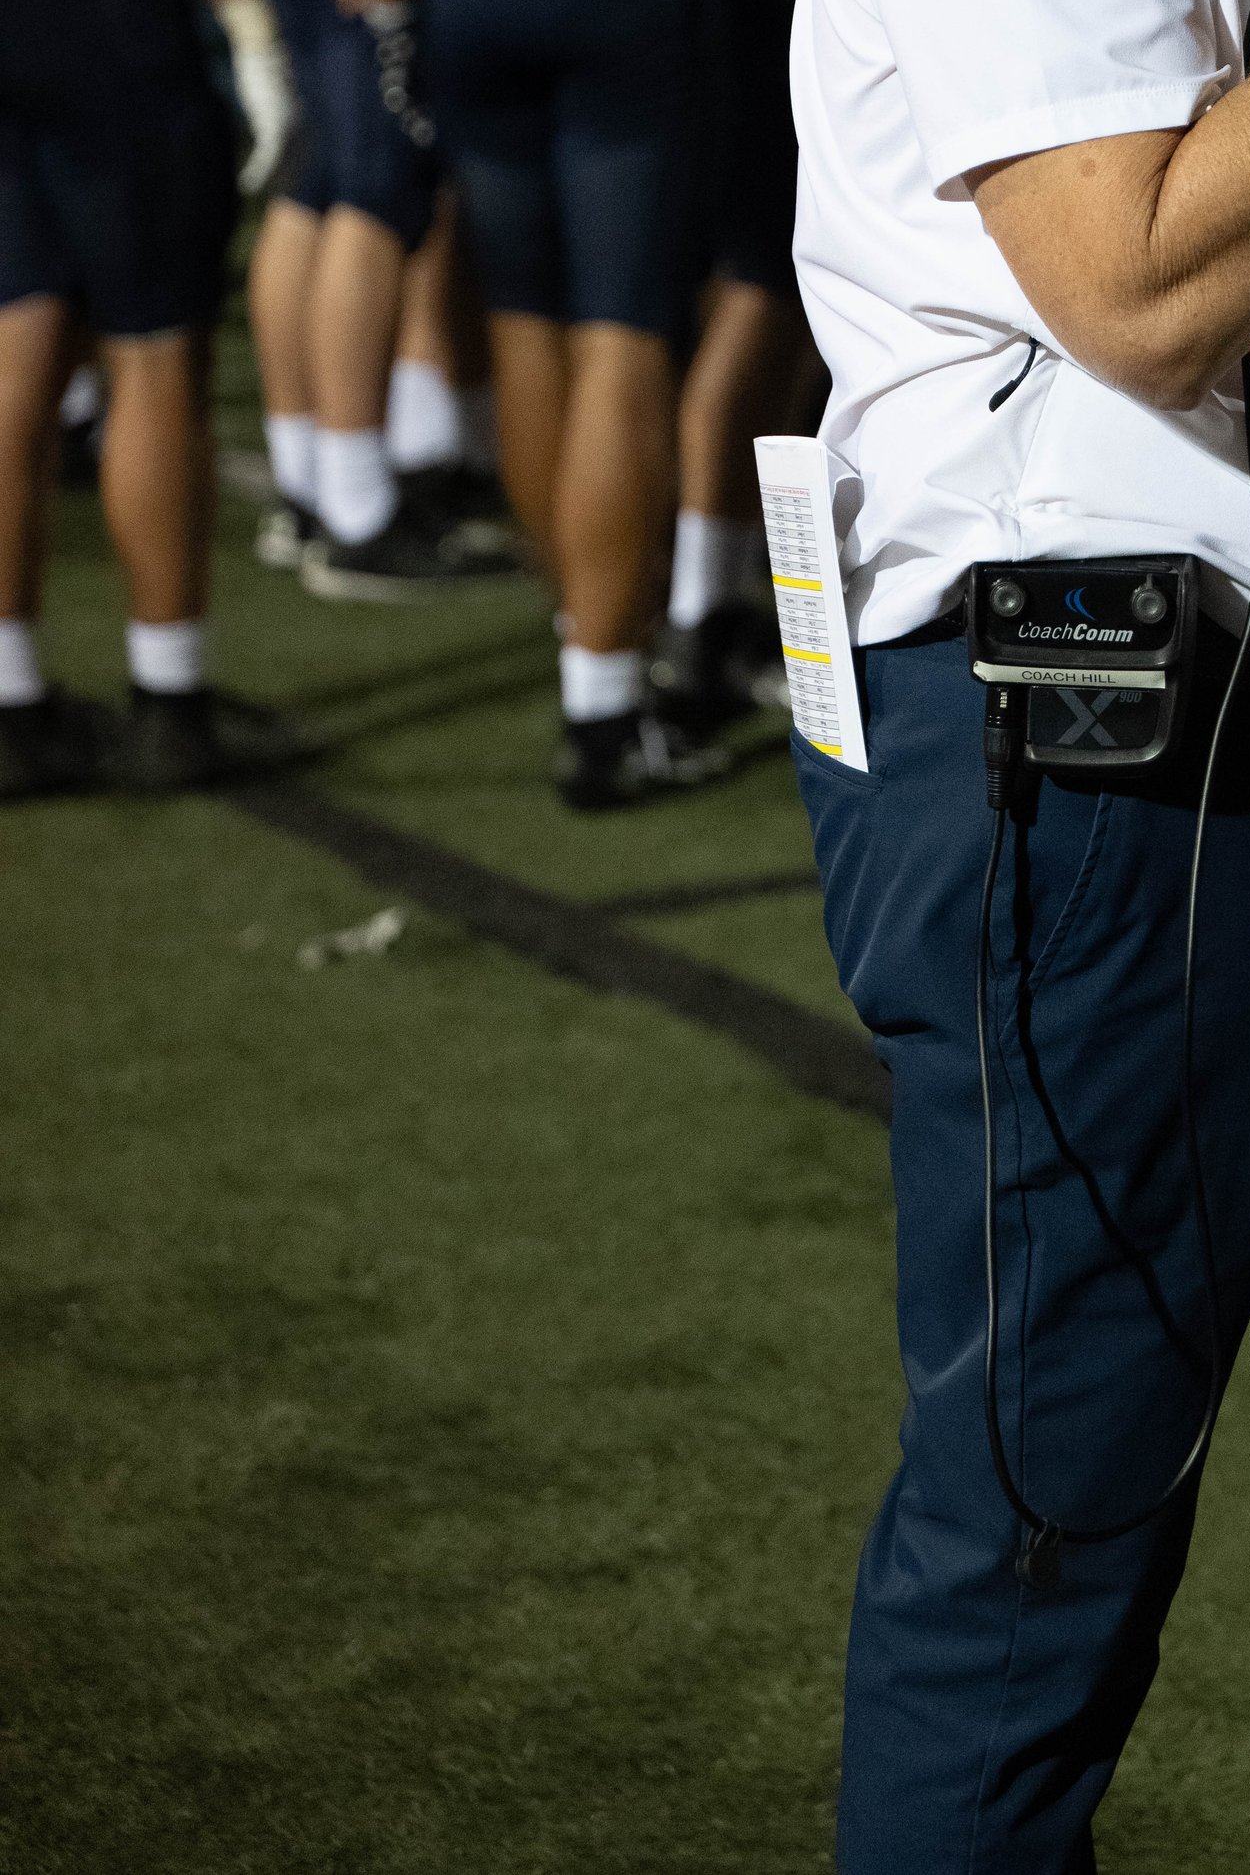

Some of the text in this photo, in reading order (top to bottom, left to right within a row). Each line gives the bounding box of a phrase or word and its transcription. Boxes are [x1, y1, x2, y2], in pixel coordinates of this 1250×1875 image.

[1018, 622, 1134, 643] CoachComm
[1021, 670, 1116, 684] COACH HILL
